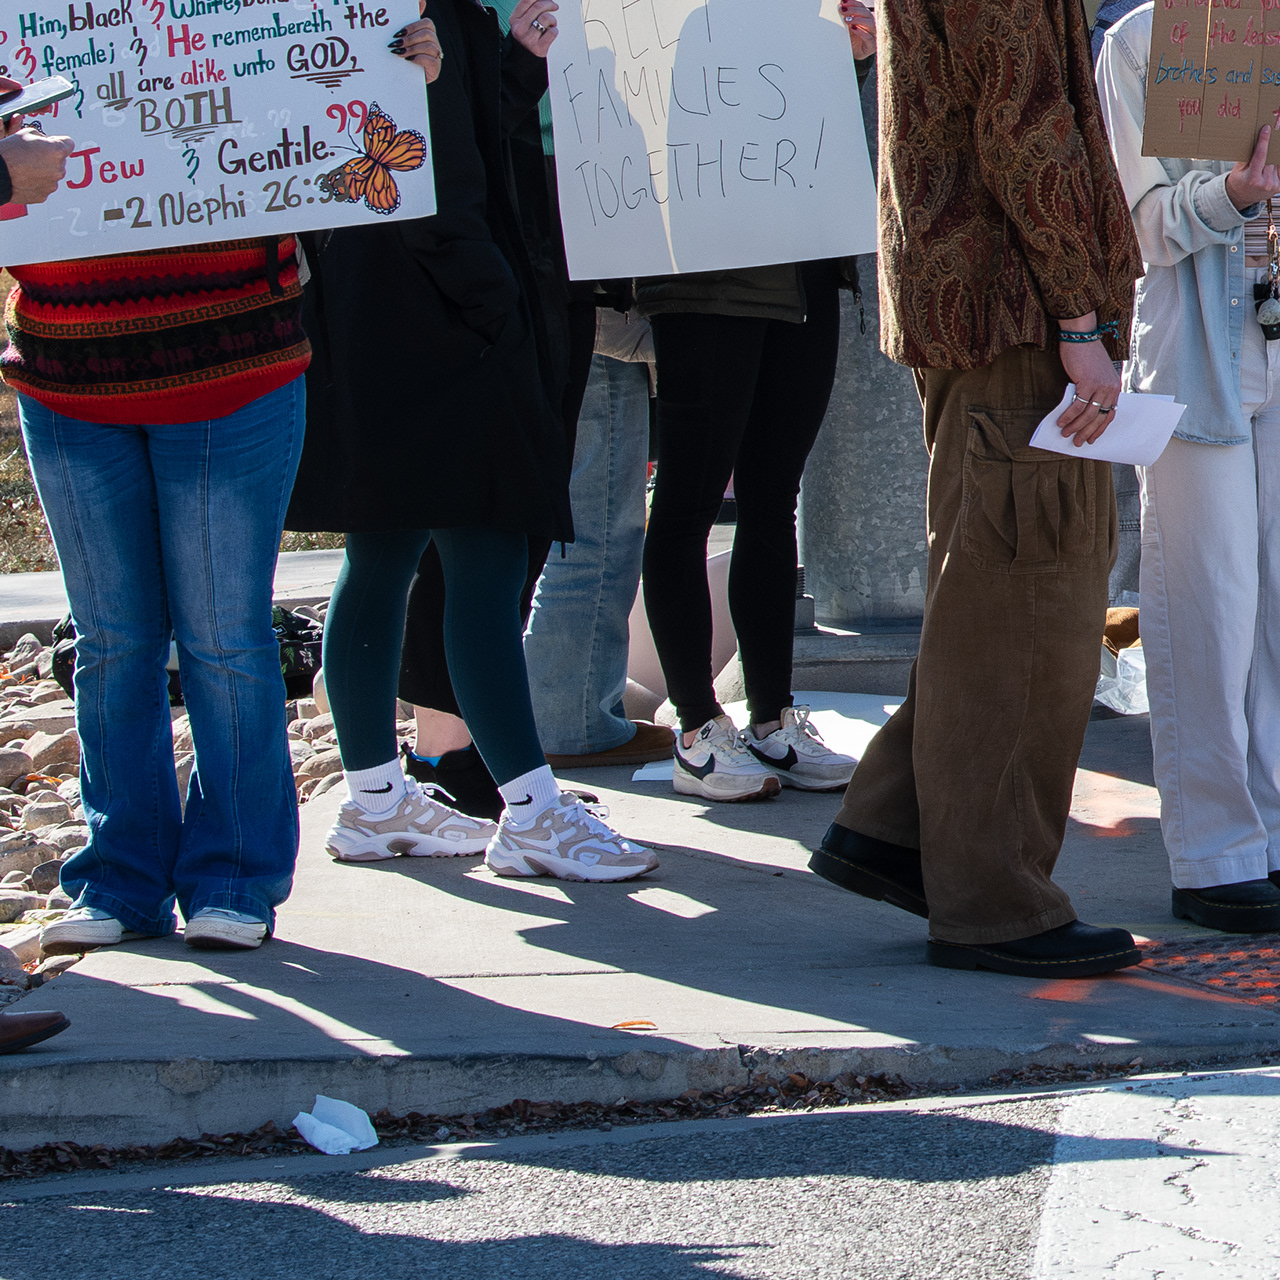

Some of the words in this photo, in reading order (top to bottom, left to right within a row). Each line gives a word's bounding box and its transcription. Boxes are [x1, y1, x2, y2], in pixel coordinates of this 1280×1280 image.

[19, 12, 67, 39] Him,
[167, 24, 207, 58] He
[212, 12, 332, 48] remembereth
[344, 3, 390, 31] the
[1170, 21, 1190, 59] of
[1209, 19, 1237, 50] the
[96, 71, 127, 101] all
[137, 67, 175, 93] are
[180, 58, 227, 86] alike
[233, 50, 276, 78] unto
[286, 36, 357, 72] GOD,
[1155, 52, 1218, 86] brothers
[1226, 60, 1252, 84] and
[135, 86, 232, 133] BOTH
[563, 63, 787, 145] FAMILIES
[1177, 97, 1201, 133] you
[1217, 93, 1242, 119] did
[66, 146, 145, 190] Jew
[575, 117, 825, 227] TOGETHER!
[158, 190, 247, 229] Nephi
